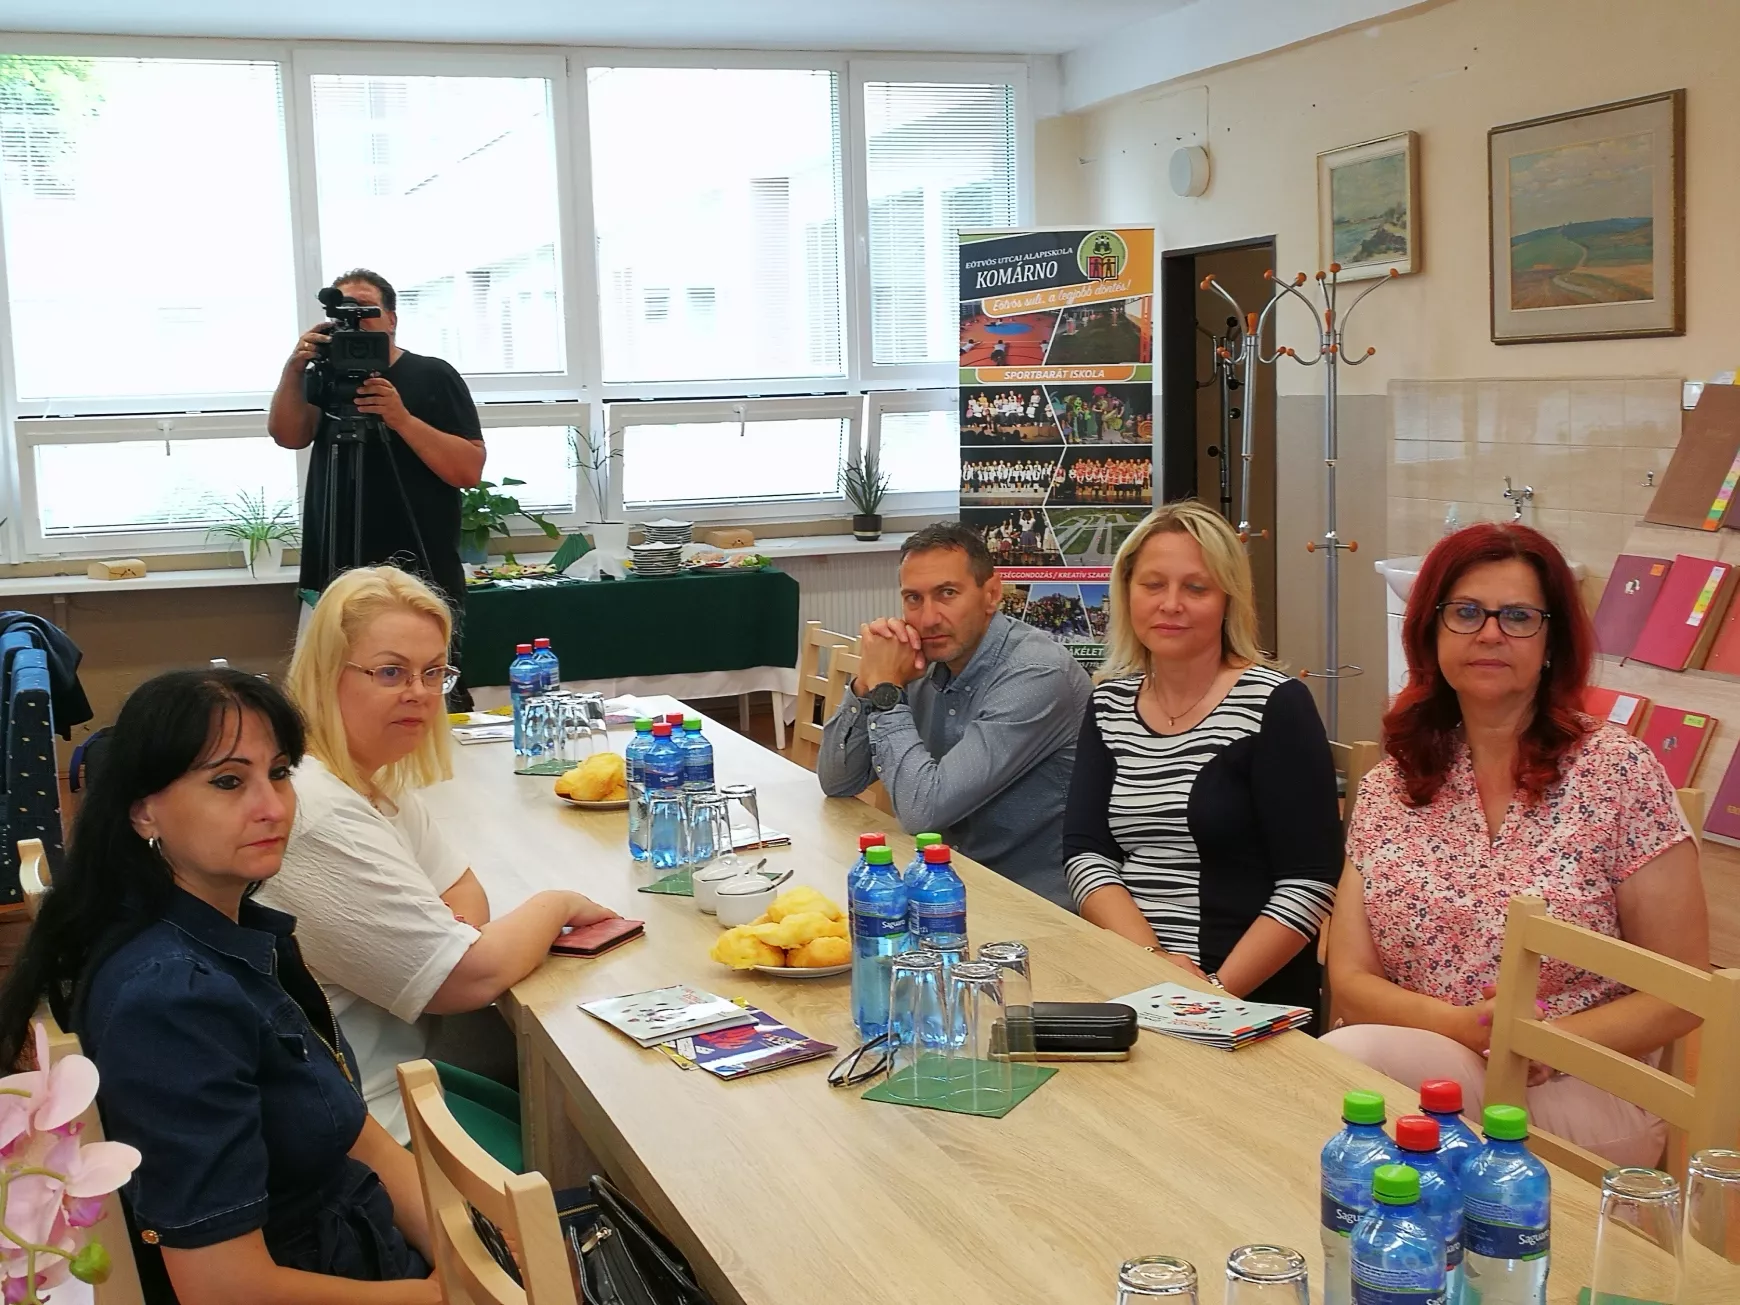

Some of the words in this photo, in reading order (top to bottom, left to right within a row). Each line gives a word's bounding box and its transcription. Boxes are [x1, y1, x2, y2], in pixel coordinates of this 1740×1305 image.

[998, 255, 1023, 264] UTCAI
[1023, 247, 1074, 261] ALAPISKOLA
[975, 261, 1058, 289] KOMÁRNO
[1047, 294, 1056, 302] a
[1003, 368, 1070, 380] SPORTBARÁT
[1070, 369, 1105, 378] ISKOLA
[1000, 570, 1053, 579] TSÉGGONDOZÁS
[1087, 571, 1112, 579] SZAKK
[1335, 1208, 1364, 1224] Sagu
[1518, 1229, 1550, 1246] Saguar
